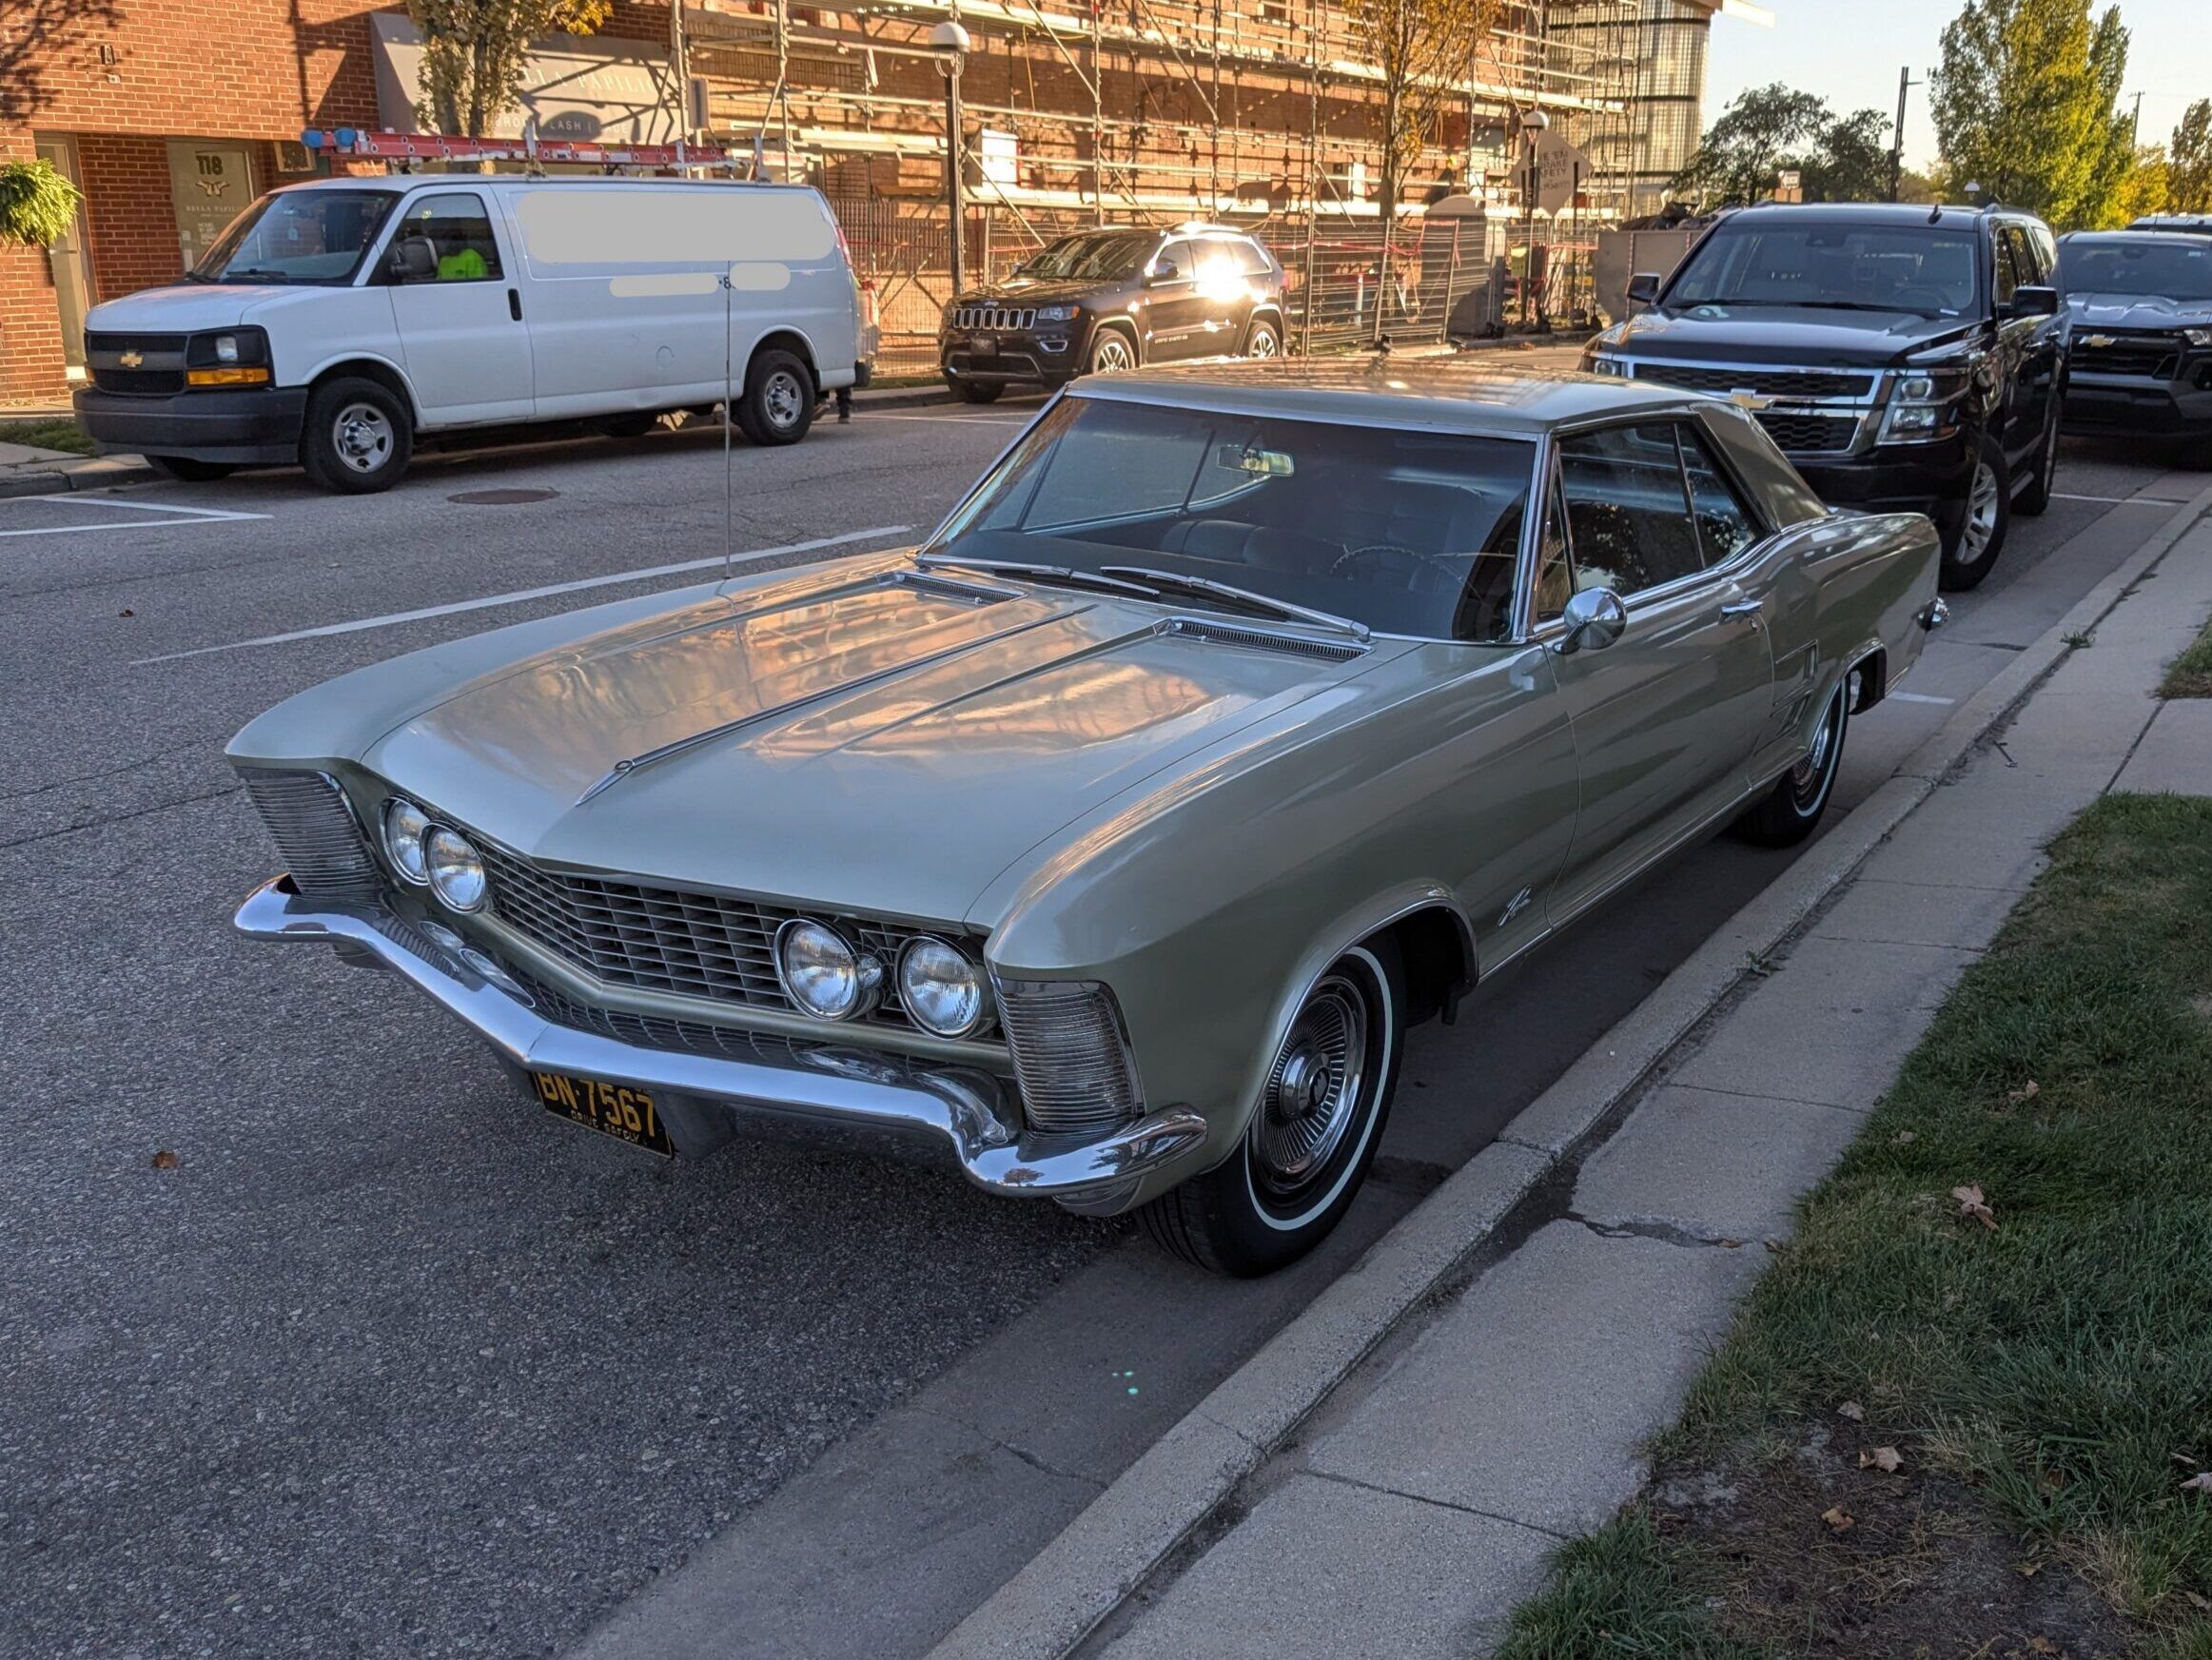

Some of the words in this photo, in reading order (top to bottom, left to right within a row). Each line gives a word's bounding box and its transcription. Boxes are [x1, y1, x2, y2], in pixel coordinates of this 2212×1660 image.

[550, 122, 581, 131] LASH
[196, 155, 224, 175] 118
[570, 1109, 599, 1128] DRIVE
[603, 1123, 640, 1142] SAFELY
